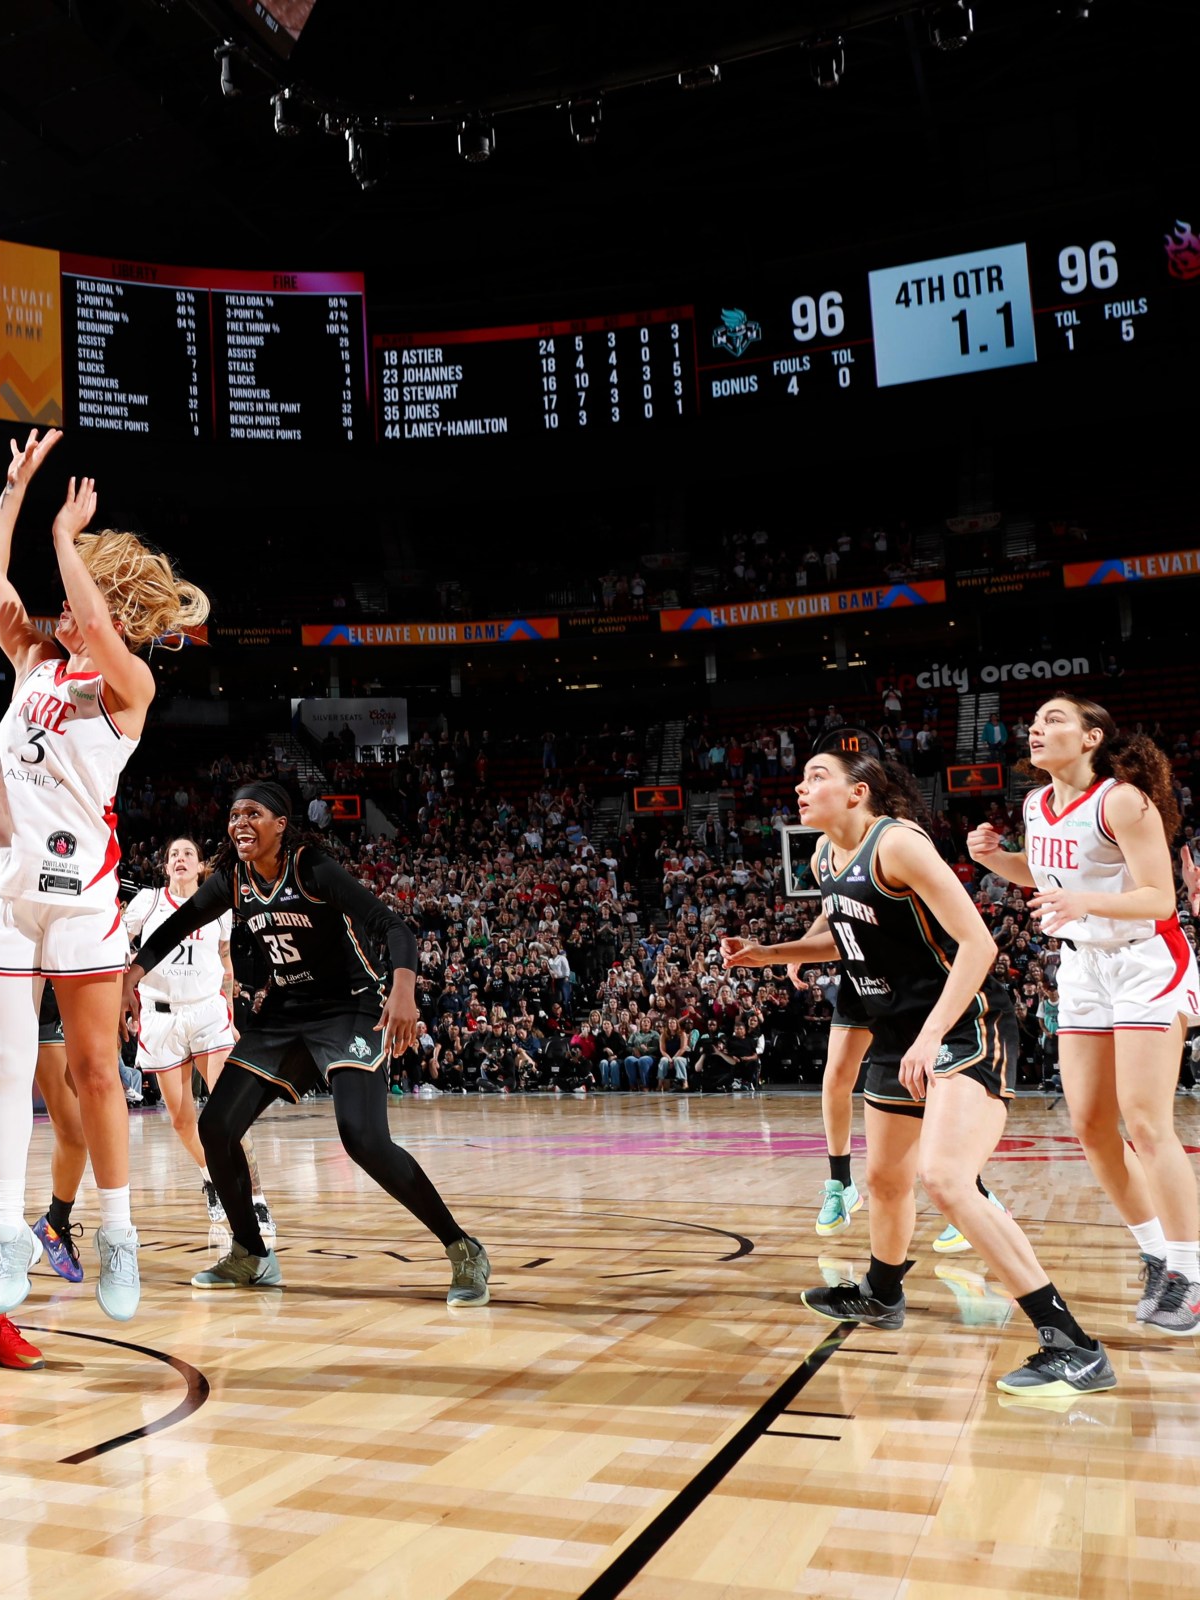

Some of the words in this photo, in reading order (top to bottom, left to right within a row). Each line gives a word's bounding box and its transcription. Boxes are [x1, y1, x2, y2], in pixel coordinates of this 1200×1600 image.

[112, 264, 158, 280] LIBERTY
[1059, 241, 1118, 294] 96
[77, 280, 95, 292] FIELD
[97, 282, 114, 295] GOAL
[116, 285, 124, 296] %
[273, 274, 298, 288] FIRE
[895, 275, 944, 308] 4TH
[953, 265, 1004, 299] QTR
[77, 293, 104, 306] 3-POINT
[106, 297, 113, 308] %
[226, 295, 245, 306] FIELD
[246, 296, 264, 307] GOAL
[266, 296, 273, 307] %
[1105, 298, 1147, 319] FOULS
[6, 308, 43, 324] YOUR
[77, 307, 94, 318] FREE
[96, 309, 120, 322] THROW
[121, 312, 129, 323] %
[226, 308, 254, 319] 3-POINT
[256, 309, 263, 320] %
[792, 292, 844, 341] 96
[1055, 310, 1080, 327] TOL
[78, 321, 114, 335] REBOUNDS
[227, 321, 244, 332] FREE
[246, 322, 271, 333] THROW
[273, 322, 280, 333] %
[951, 301, 1015, 355] 1.1
[1122, 320, 1134, 340] 5
[78, 334, 106, 348] ASSISTS
[227, 335, 264, 346] REBOUNDS
[384, 351, 397, 365] 18
[402, 348, 442, 364] ASTIER
[539, 340, 554, 354] 24
[576, 336, 582, 350] 5
[608, 332, 615, 347] 3
[641, 328, 648, 342] 0
[671, 324, 678, 338] 3
[1066, 330, 1074, 350] 1
[78, 348, 104, 360] STEALS
[228, 348, 256, 359] ASSISTS
[832, 349, 854, 364] TOL
[78, 361, 104, 374] BLOCKS
[228, 362, 254, 372] STEALS
[383, 369, 398, 383] 23
[403, 366, 462, 382] JOHANNES
[542, 358, 555, 372] 18
[576, 355, 584, 369] 4
[609, 351, 616, 365] 4
[642, 347, 649, 361] 0
[674, 343, 678, 357] 1
[774, 356, 810, 375] FOULS
[79, 375, 119, 389] TURNOVERS
[229, 375, 256, 386] BLOCKS
[384, 388, 398, 402] 30
[403, 384, 458, 401] STEWART
[543, 376, 556, 391] 16
[575, 373, 588, 388] 10
[610, 370, 618, 384] 4
[643, 366, 650, 380] 3
[674, 362, 681, 376] 5
[839, 367, 850, 387] 0
[229, 388, 270, 399] TURNOVERS
[712, 376, 758, 397] BONUS
[788, 376, 799, 395] 4
[79, 389, 103, 401] POINTS
[105, 392, 112, 402] IN
[114, 392, 126, 403] THE
[128, 394, 148, 405] PAINT
[384, 406, 399, 420] 35
[404, 404, 439, 419] JONES
[544, 395, 556, 410] 17
[578, 392, 585, 406] 7
[611, 388, 618, 403] 3
[644, 384, 651, 399] 0
[674, 380, 682, 395] 3
[80, 402, 102, 414] BENCH
[104, 405, 128, 417] POINTS
[230, 401, 254, 412] POINTS
[256, 402, 264, 412] IN
[265, 402, 279, 413] THE
[280, 403, 301, 413] PAINT
[80, 416, 94, 427] 2ND
[95, 417, 122, 430] CHANCE
[124, 420, 149, 432] POINTS
[230, 415, 253, 425] BENCH
[255, 415, 280, 426] POINTS
[385, 424, 400, 438] 44
[405, 418, 507, 438] LANEY-HAMILTON
[544, 413, 558, 428] 10
[579, 410, 586, 425] 3
[612, 407, 619, 422] 3
[645, 403, 652, 418] 0
[678, 400, 682, 414] 1
[231, 428, 245, 438] 2ND
[246, 429, 275, 439] CHANCE
[276, 429, 301, 440] POINTS
[956, 578, 992, 589] SPIRIT
[996, 570, 1051, 584] MOUNTAIN
[983, 582, 1024, 594] CASINO
[710, 602, 778, 626] ELEVATE
[785, 596, 830, 616] YOUR
[838, 590, 884, 610] GAME
[348, 626, 410, 642] ELEVATE
[417, 624, 457, 641] YOUR
[463, 624, 504, 641] GAME
[916, 662, 969, 694] city
[980, 656, 1090, 684] oregon
[69, 685, 95, 700] chime
[18, 691, 76, 735] FIRE
[21, 727, 46, 764] 3
[4, 768, 64, 788] ASHIFY
[1066, 820, 1092, 828] chime
[1032, 836, 1079, 870] FIRE
[838, 894, 880, 926] YORK
[272, 912, 313, 928] YORK
[171, 944, 193, 965] 21
[263, 933, 301, 964] 35
[162, 968, 201, 977] LASHIFY
[286, 970, 311, 981] Liberty
